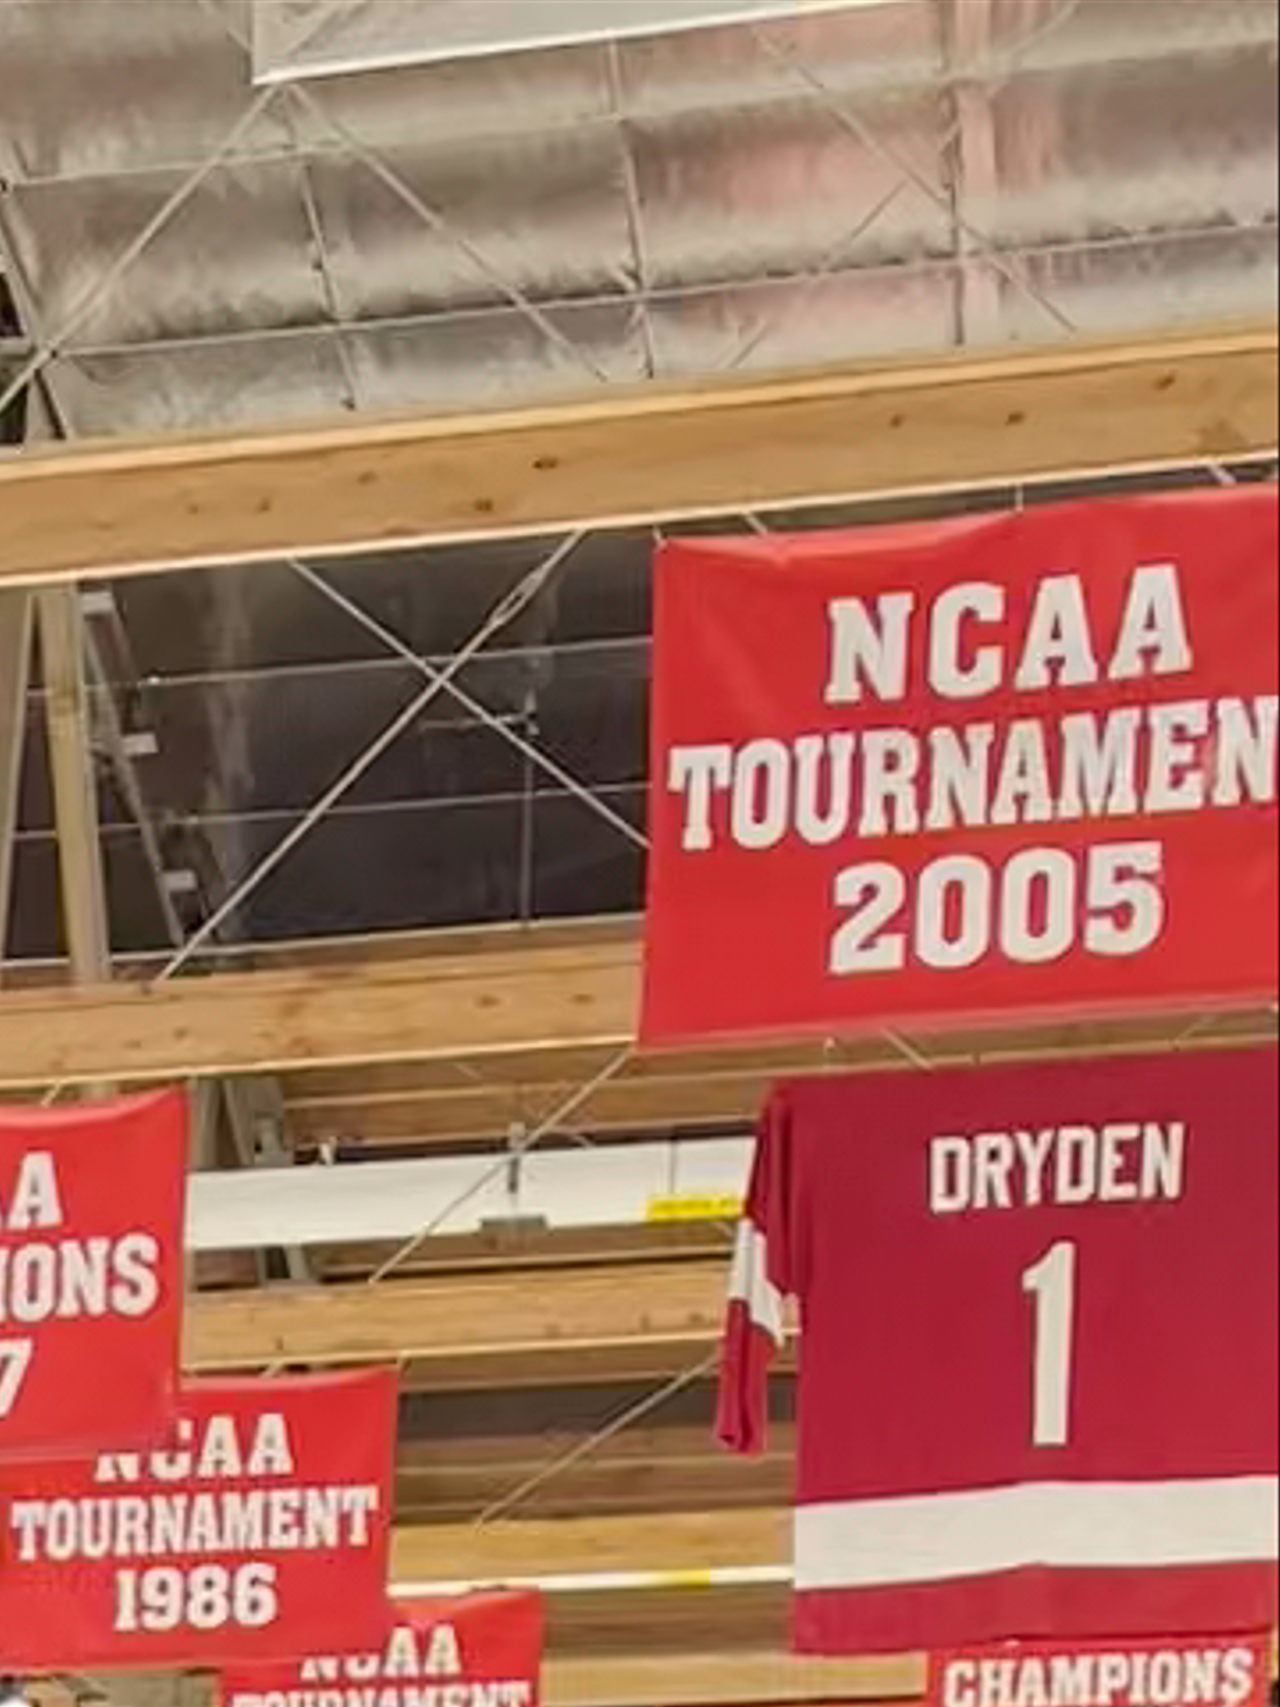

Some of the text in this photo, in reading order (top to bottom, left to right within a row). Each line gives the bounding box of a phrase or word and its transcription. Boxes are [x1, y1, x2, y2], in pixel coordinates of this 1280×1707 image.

[826, 564, 1192, 705] NCAA
[828, 842, 1165, 975] 2005
[929, 1122, 1184, 1214] DRYDEN
[1023, 1241, 1076, 1447] 1
[10, 1485, 379, 1563] TOURNAMENT
[115, 1562, 278, 1633] 1986
